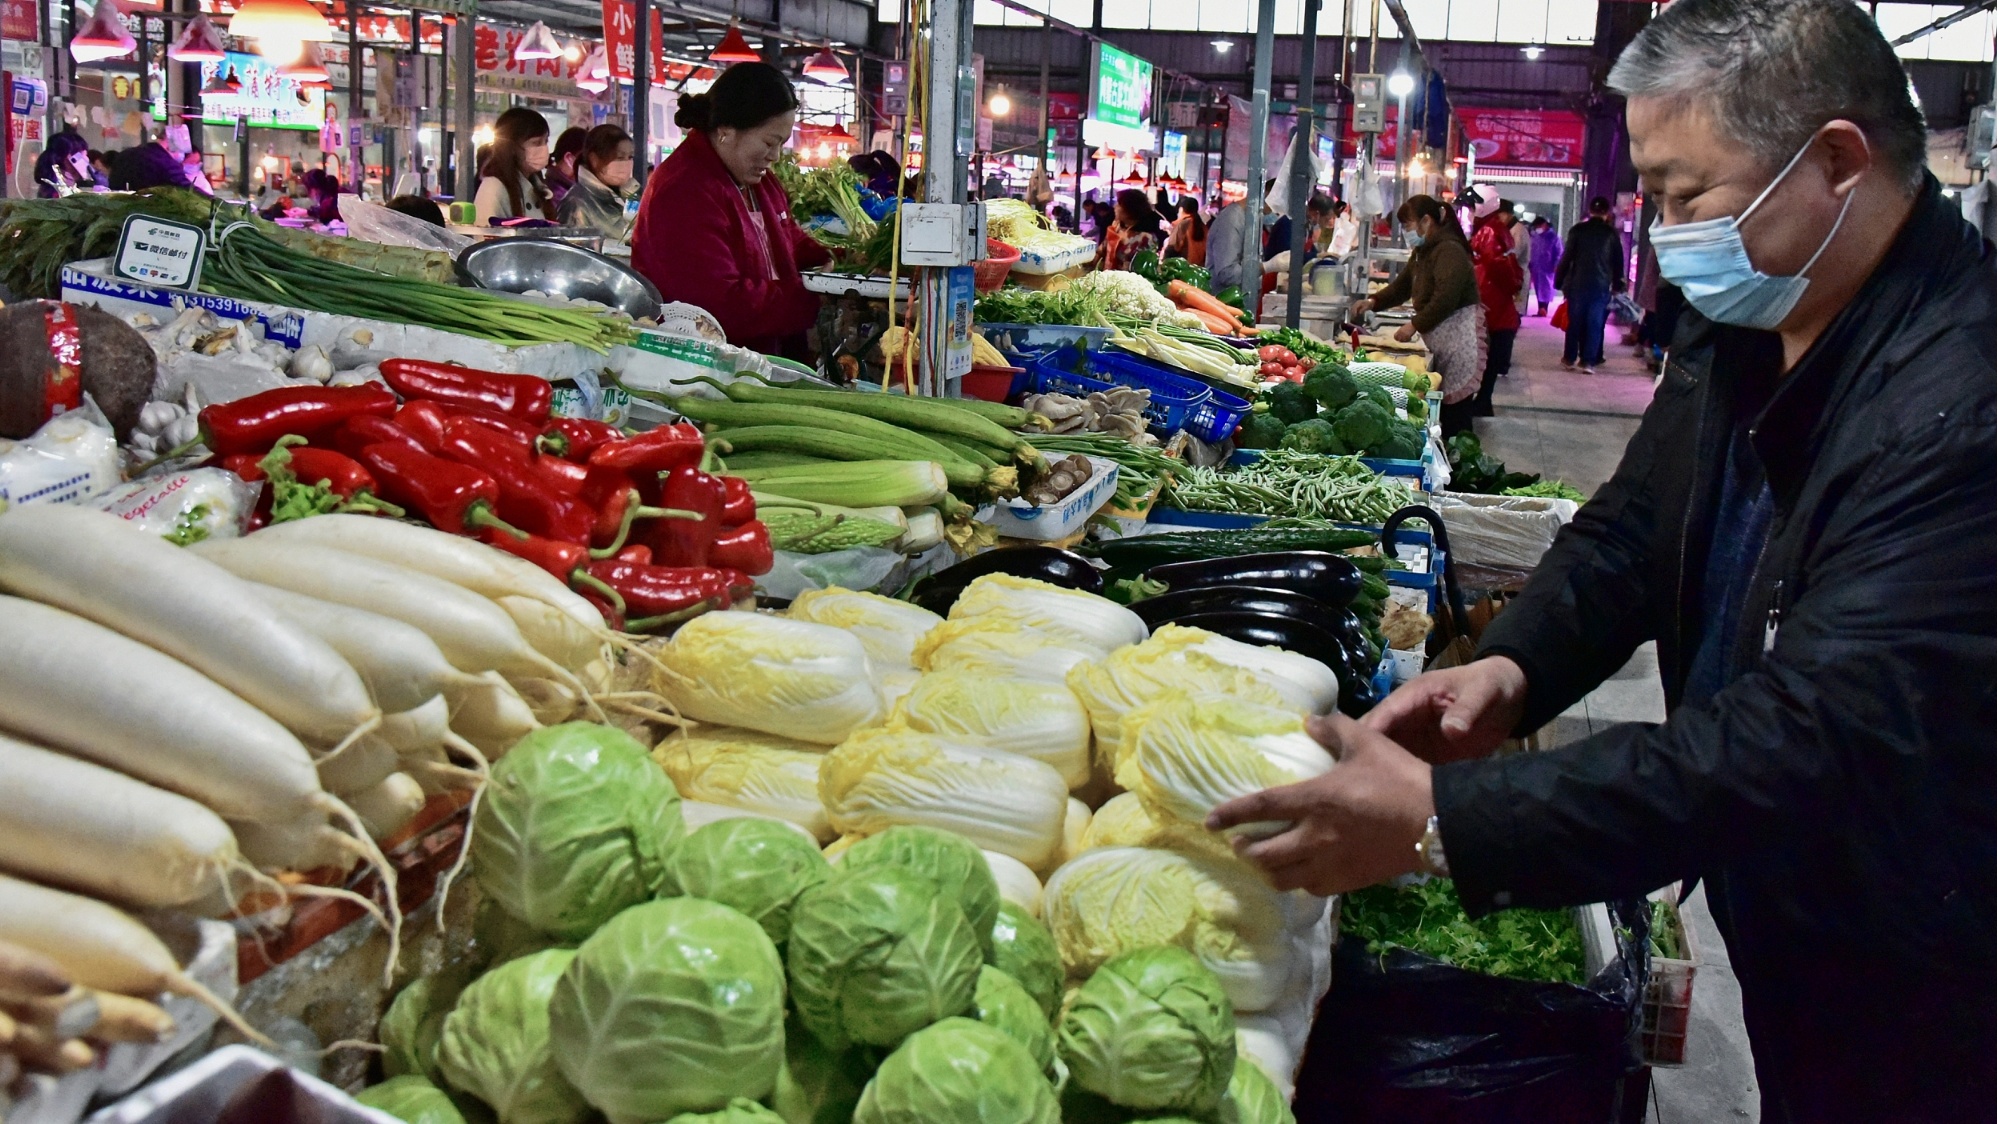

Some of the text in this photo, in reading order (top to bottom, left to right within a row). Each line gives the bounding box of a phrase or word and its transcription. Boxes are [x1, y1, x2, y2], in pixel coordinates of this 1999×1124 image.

[149, 244, 188, 259] 微信邮付
[117, 475, 190, 520] egetable
